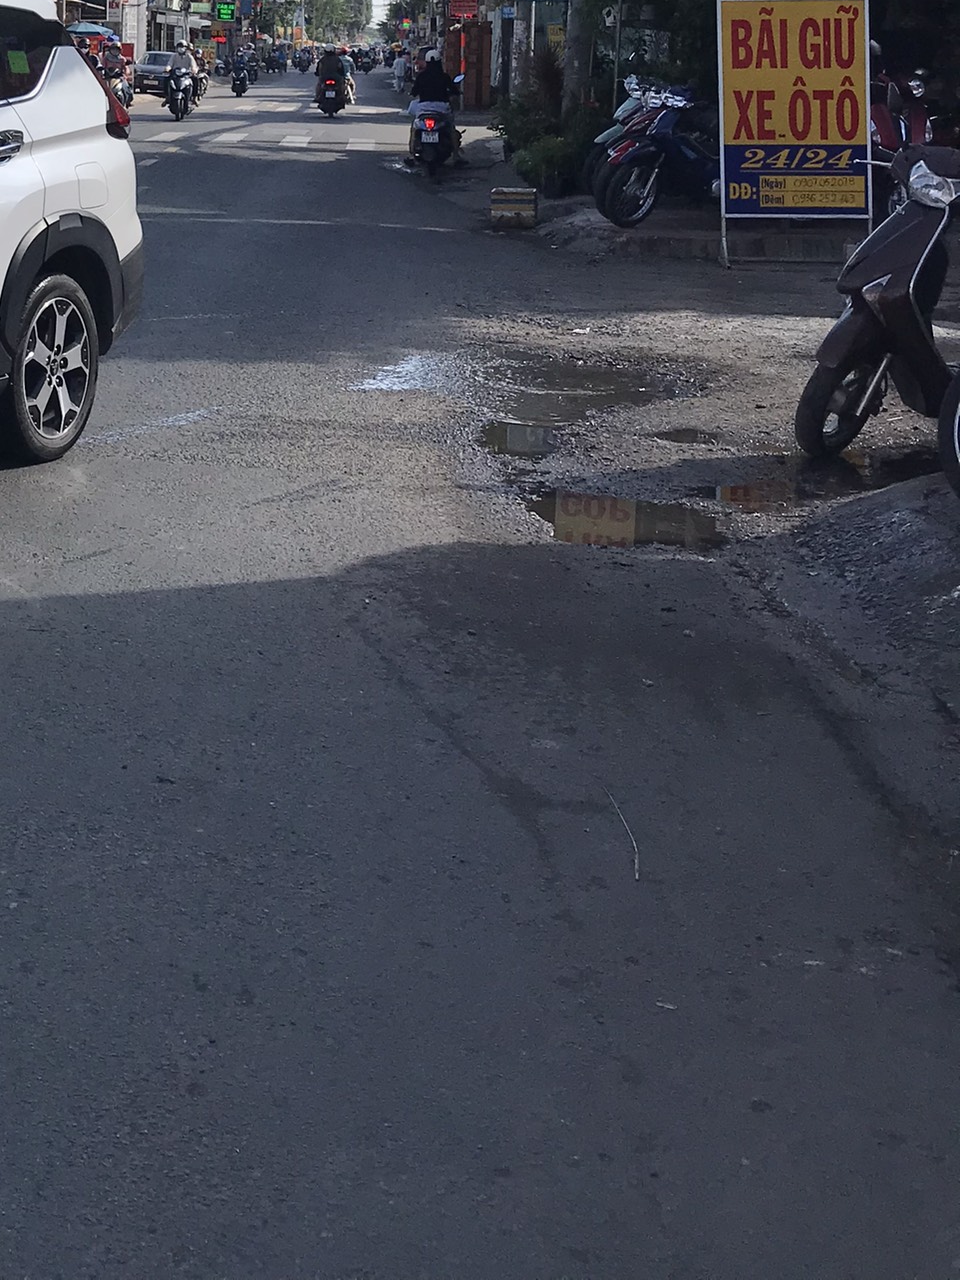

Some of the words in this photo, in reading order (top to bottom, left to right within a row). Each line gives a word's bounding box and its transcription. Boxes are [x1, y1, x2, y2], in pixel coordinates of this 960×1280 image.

[731, 7, 788, 70] BÃI
[798, 5, 860, 70] GIỮ
[733, 90, 776, 141] XE
[788, 75, 860, 142] ÔTÔ
[741, 148, 853, 170] 24/24
[729, 182, 757, 200] DĐ:
